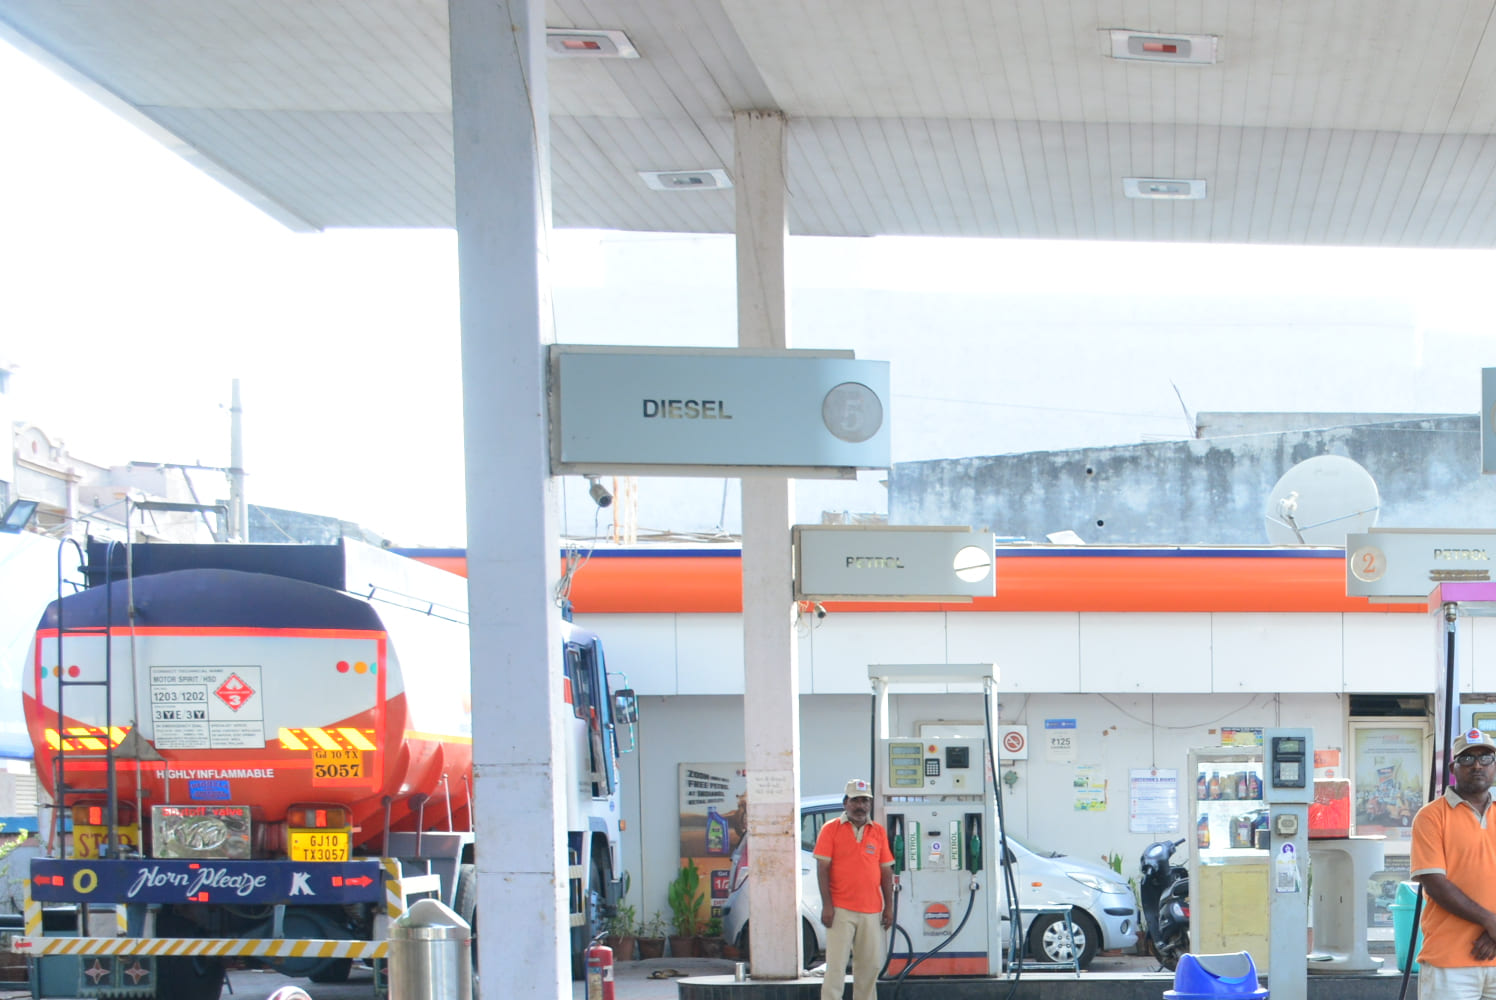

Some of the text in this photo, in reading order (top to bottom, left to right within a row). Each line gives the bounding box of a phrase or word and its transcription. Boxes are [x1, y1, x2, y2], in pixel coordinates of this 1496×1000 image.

[642, 399, 733, 420] DIESEL
[1434, 548, 1491, 561] PETROL
[1362, 553, 1376, 574] 2
[153, 675, 176, 683] MOTOR
[154, 691, 205, 701] 1203 1202
[228, 694, 241, 706] 3
[156, 768, 275, 779] HGHLY INFLAMMABLE
[315, 763, 360, 778] 3057
[213, 807, 243, 816] valve
[310, 835, 338, 847] GJ10
[303, 848, 345, 861] TX3057
[72, 868, 98, 894] O
[127, 867, 190, 898] Horn
[289, 872, 316, 897] K
